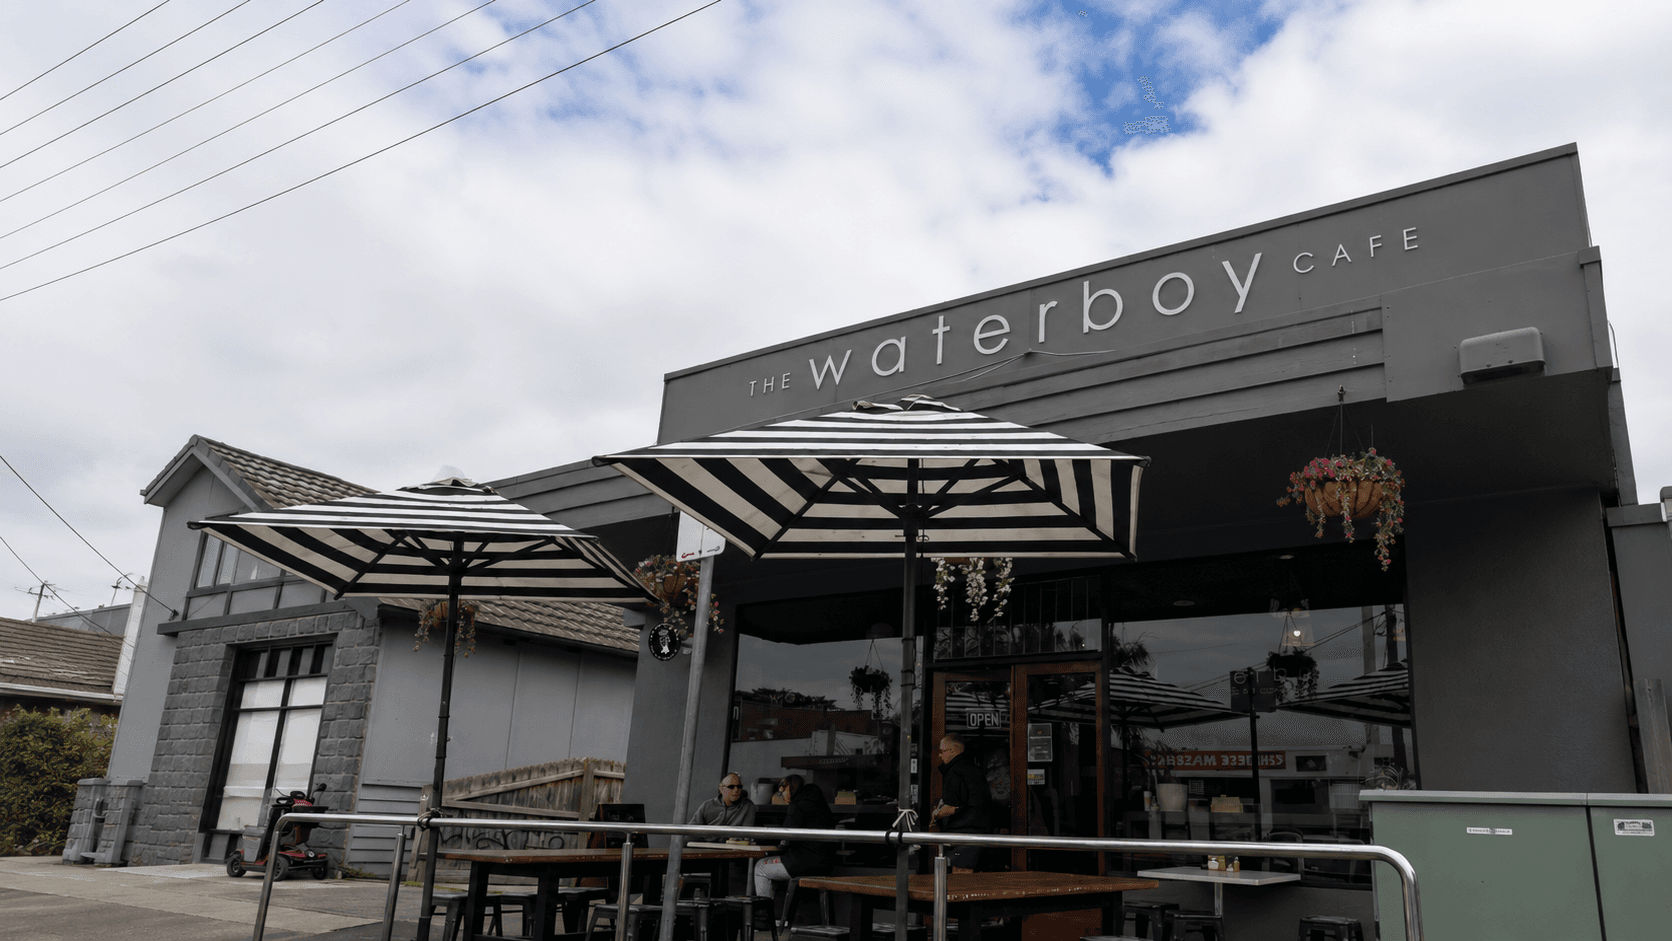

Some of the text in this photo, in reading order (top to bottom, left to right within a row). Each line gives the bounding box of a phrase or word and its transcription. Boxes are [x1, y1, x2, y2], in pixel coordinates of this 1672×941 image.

[748, 226, 1419, 397] THE waterboy CAFE
[969, 713, 999, 728] OPEN
